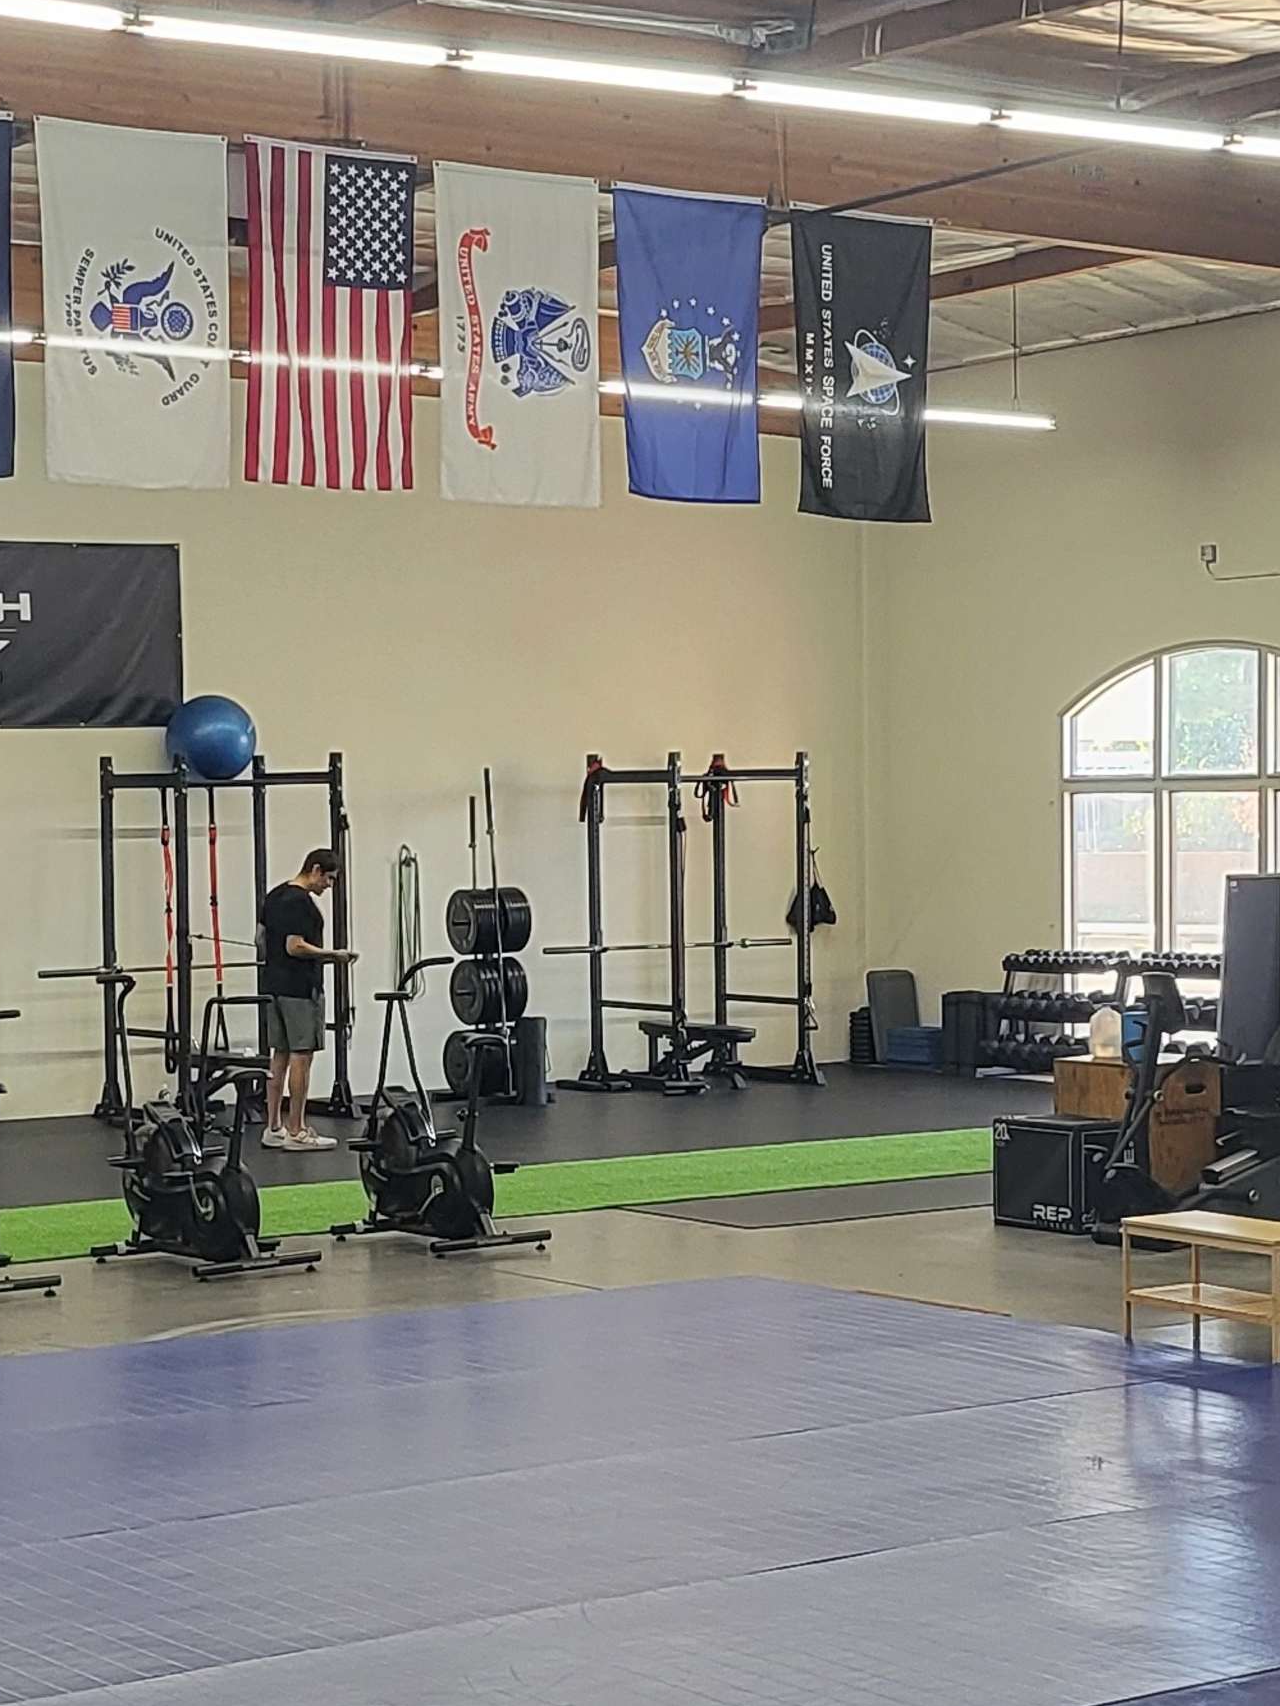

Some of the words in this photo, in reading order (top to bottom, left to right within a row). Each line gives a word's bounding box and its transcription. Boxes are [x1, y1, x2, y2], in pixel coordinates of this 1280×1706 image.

[155, 227, 195, 267] UNITED
[821, 244, 833, 302] UNITED
[72, 248, 95, 306] SEMPER
[193, 267, 218, 319] STATES
[459, 247, 475, 307] UNITED
[201, 321, 219, 369] COT
[470, 314, 482, 374] STATES
[822, 309, 834, 369] STATES
[161, 373, 200, 406] GUARD
[466, 384, 477, 426] ARMY
[820, 375, 834, 429] SPACE
[820, 435, 833, 490] FORCE
[1032, 1204, 1073, 1222] REP
